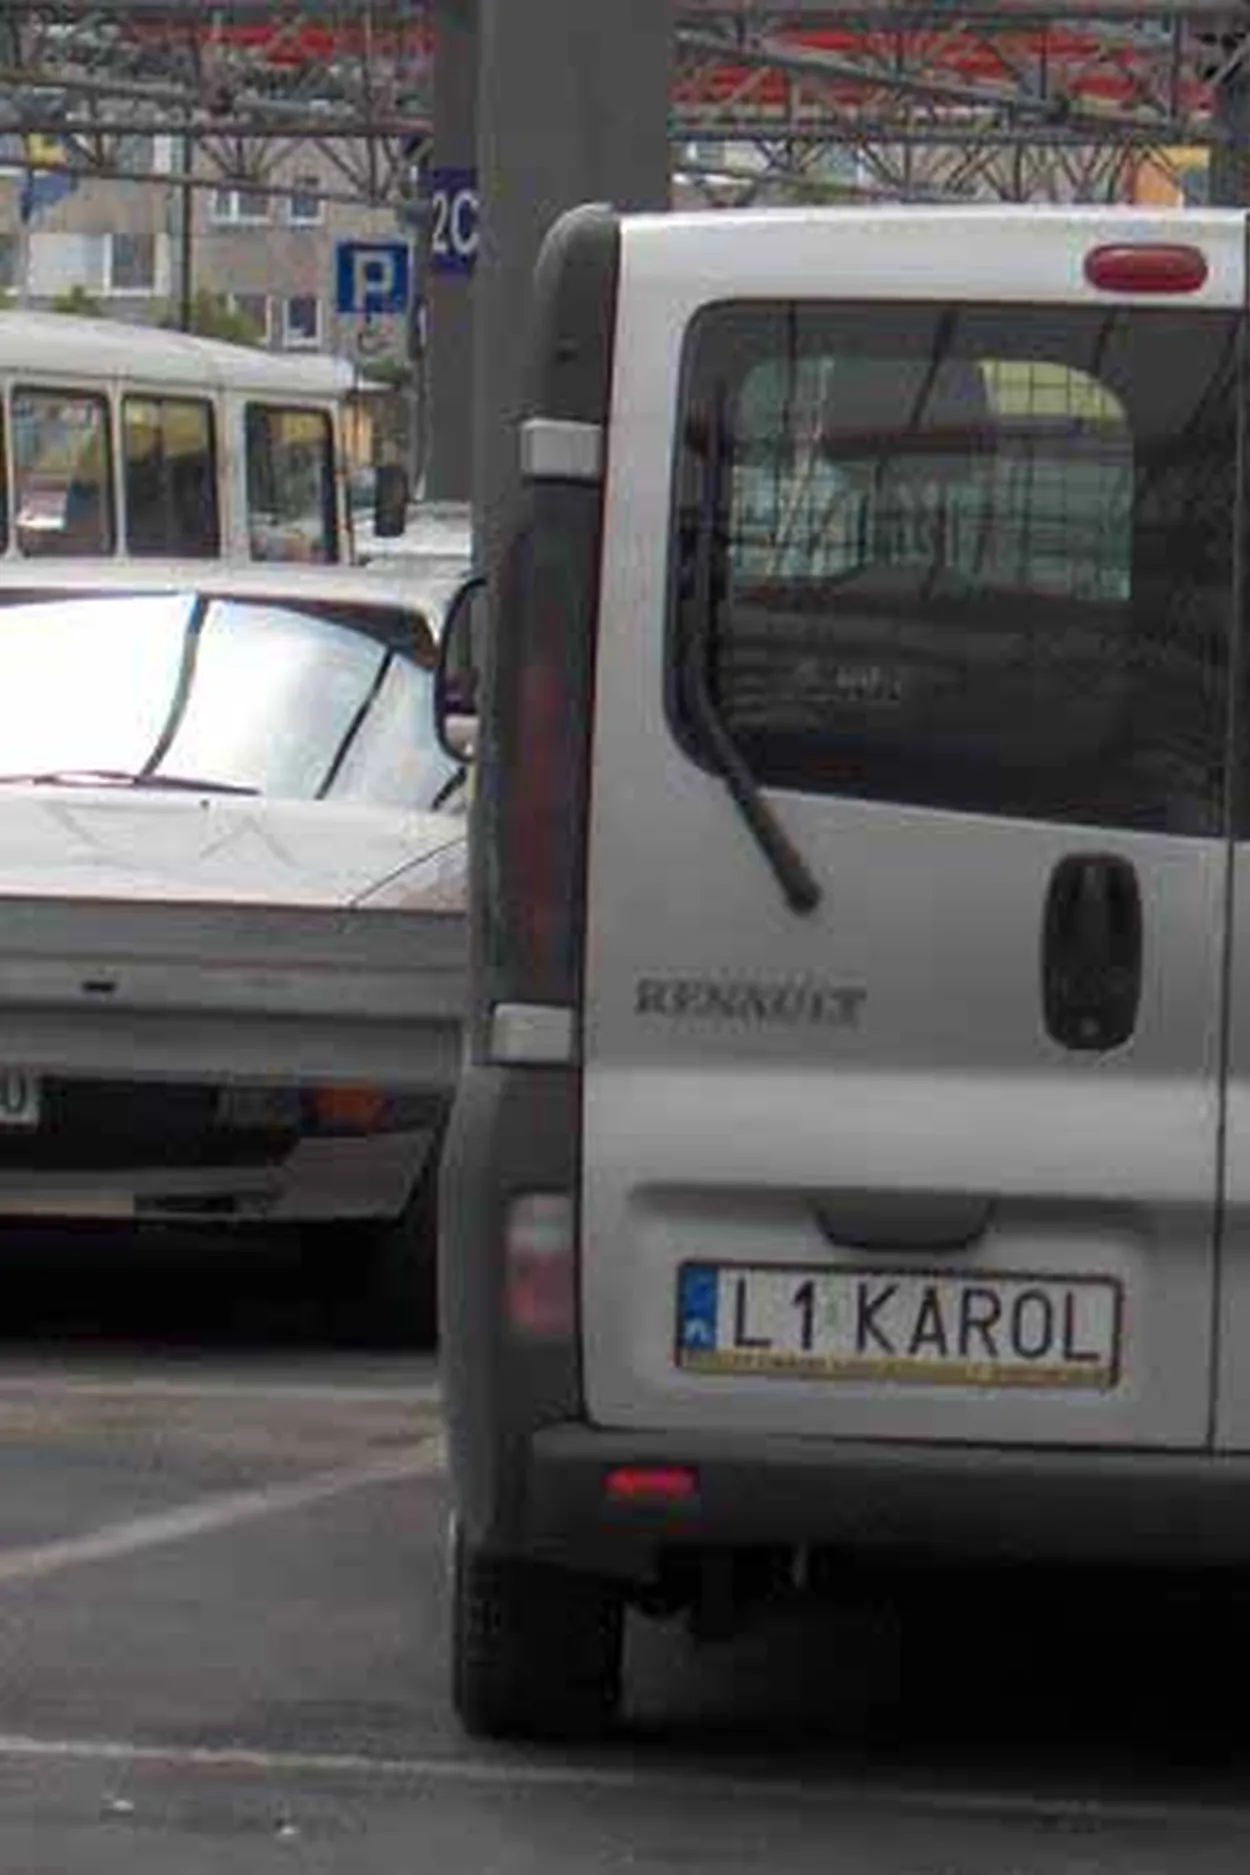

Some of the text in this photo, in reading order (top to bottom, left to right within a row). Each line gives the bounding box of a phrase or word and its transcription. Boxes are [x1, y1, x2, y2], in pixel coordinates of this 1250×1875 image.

[432, 189, 480, 255] 2C
[353, 252, 394, 309] P
[633, 977, 868, 1028] RENAULT
[734, 1276, 1100, 1361] L1 KAROL
